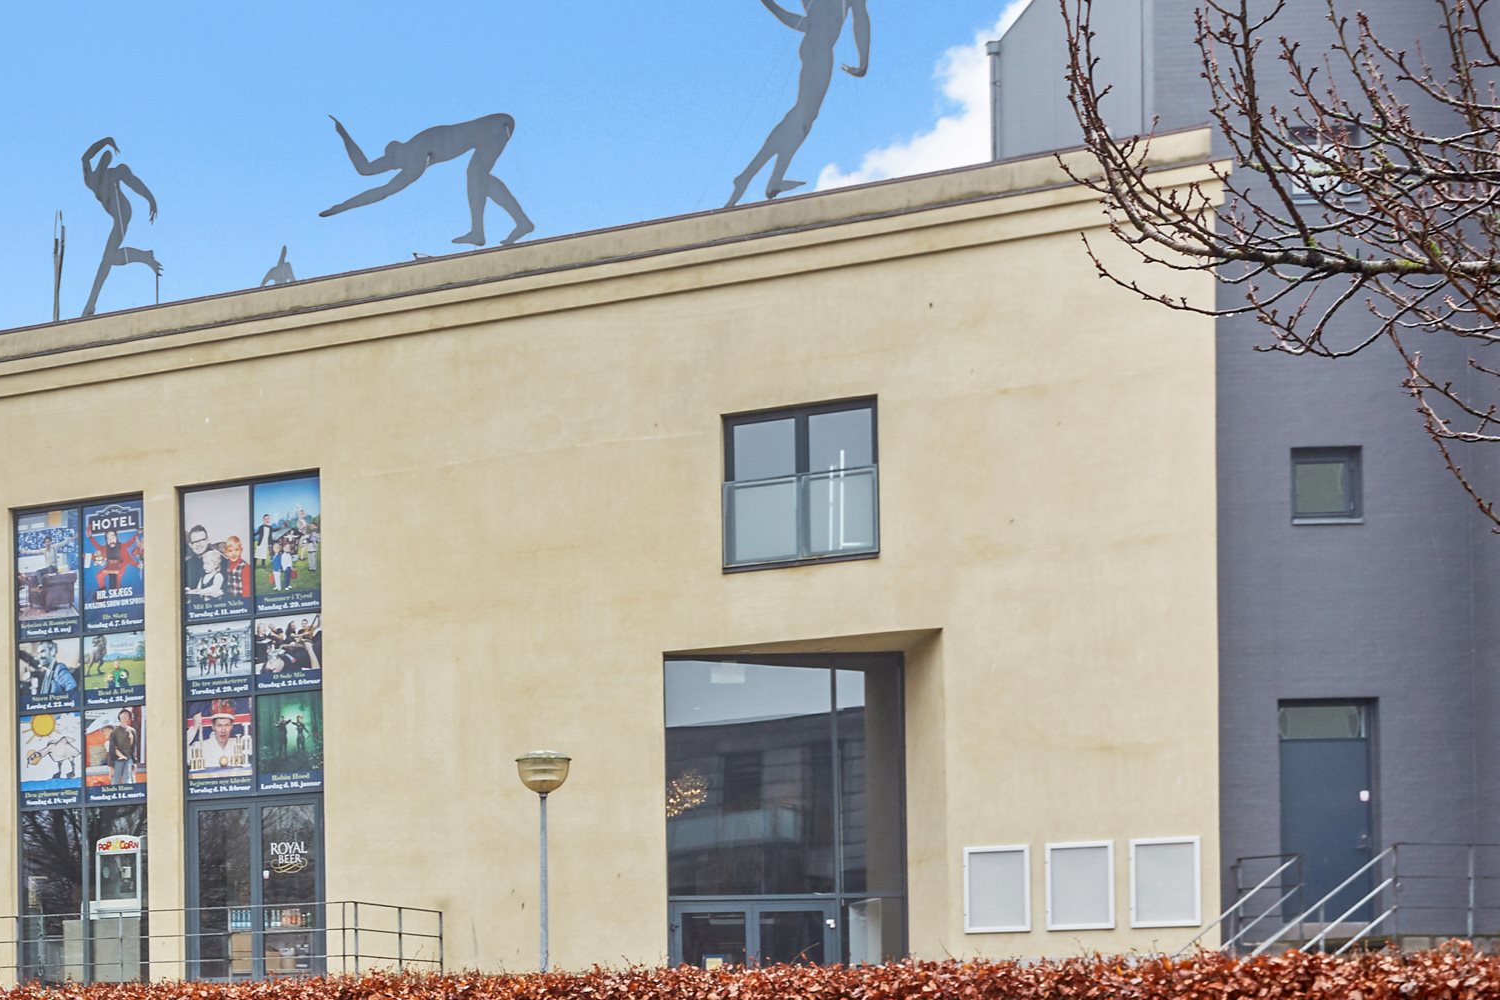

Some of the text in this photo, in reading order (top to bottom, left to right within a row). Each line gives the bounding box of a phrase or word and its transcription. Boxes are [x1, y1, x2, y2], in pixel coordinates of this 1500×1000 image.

[92, 515, 136, 531] HOTEL
[96, 586, 133, 600] HR. SKÆGS
[258, 603, 282, 611] Mandag
[189, 610, 213, 618] Torsdag
[191, 687, 215, 695] Torsdag
[233, 684, 248, 692] april
[64, 699, 75, 707] maj
[189, 786, 213, 794] Torsdag
[63, 796, 77, 805] april
[98, 840, 139, 851] POP CORN
[270, 841, 308, 855] ROYAL
[278, 854, 302, 864] BEER
